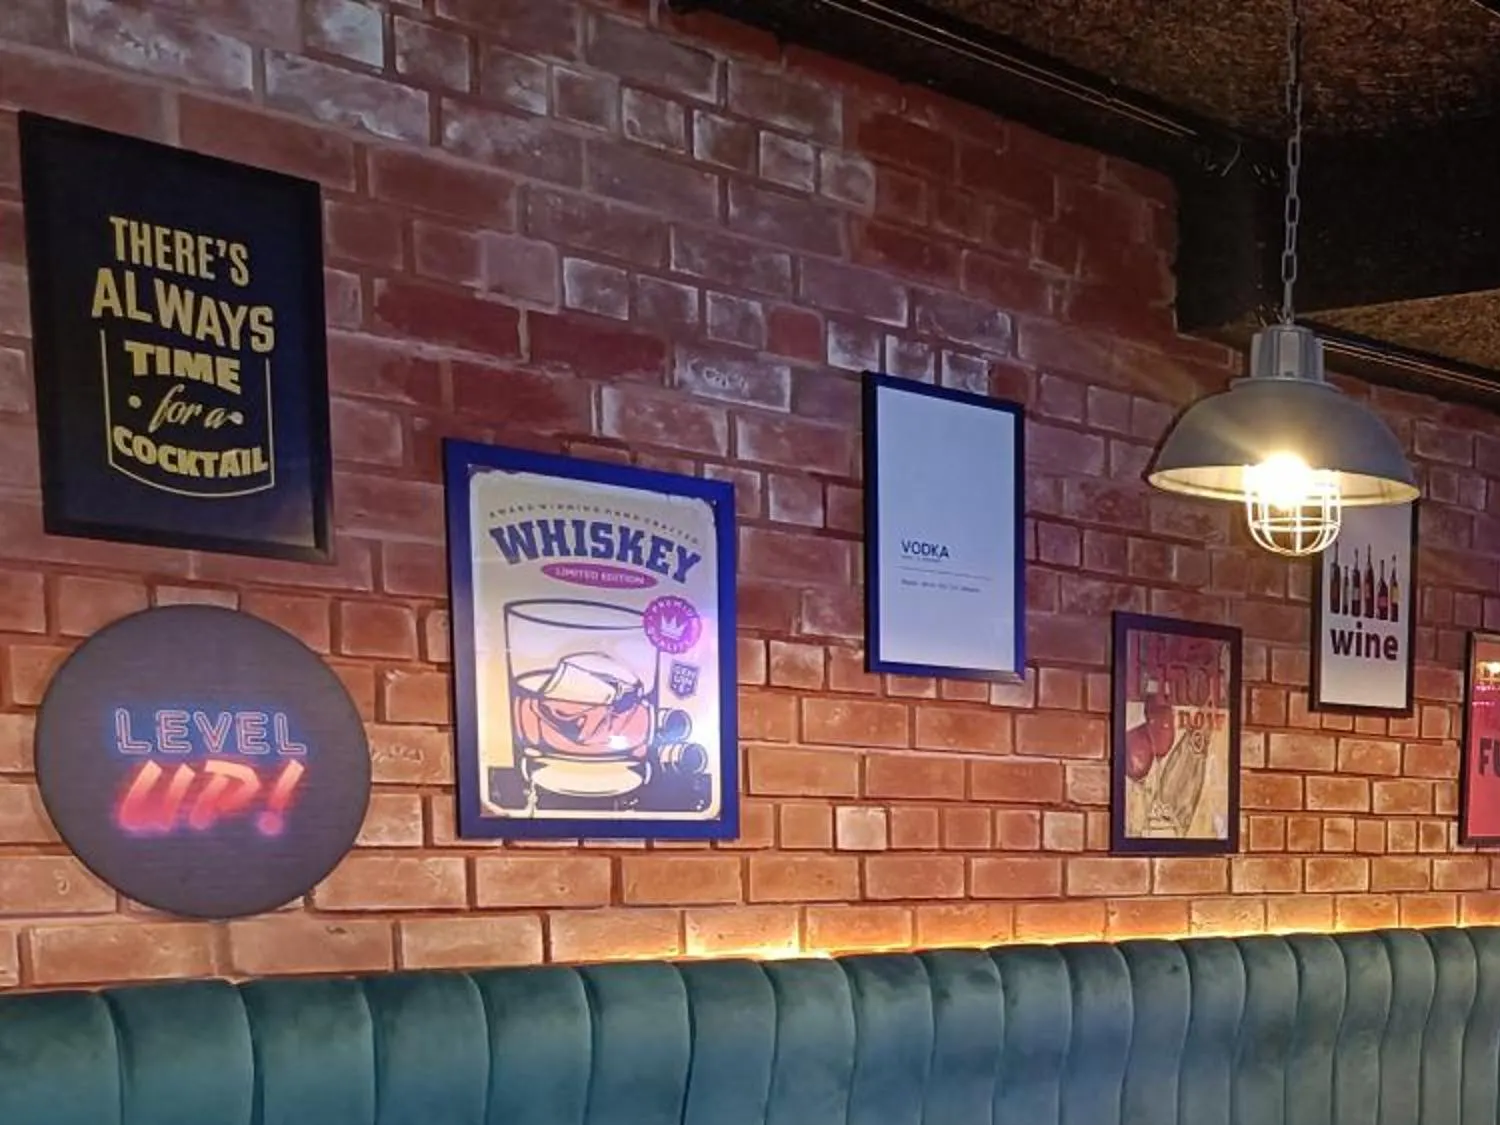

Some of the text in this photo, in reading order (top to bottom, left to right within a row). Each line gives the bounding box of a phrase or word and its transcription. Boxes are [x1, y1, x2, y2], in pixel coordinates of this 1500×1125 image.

[109, 215, 249, 287] THERE'S
[91, 267, 275, 353] ALWAYS
[124, 340, 241, 394] TIME
[148, 383, 231, 433] for a
[113, 425, 269, 479] COCKTAIL
[489, 518, 702, 584] WHISKEY
[554, 565, 645, 585] LIMITED EDITION
[901, 539, 949, 558] VODKA
[1330, 621, 1398, 661] wine
[115, 707, 307, 755] LEVEL
[117, 759, 305, 836] UP!
